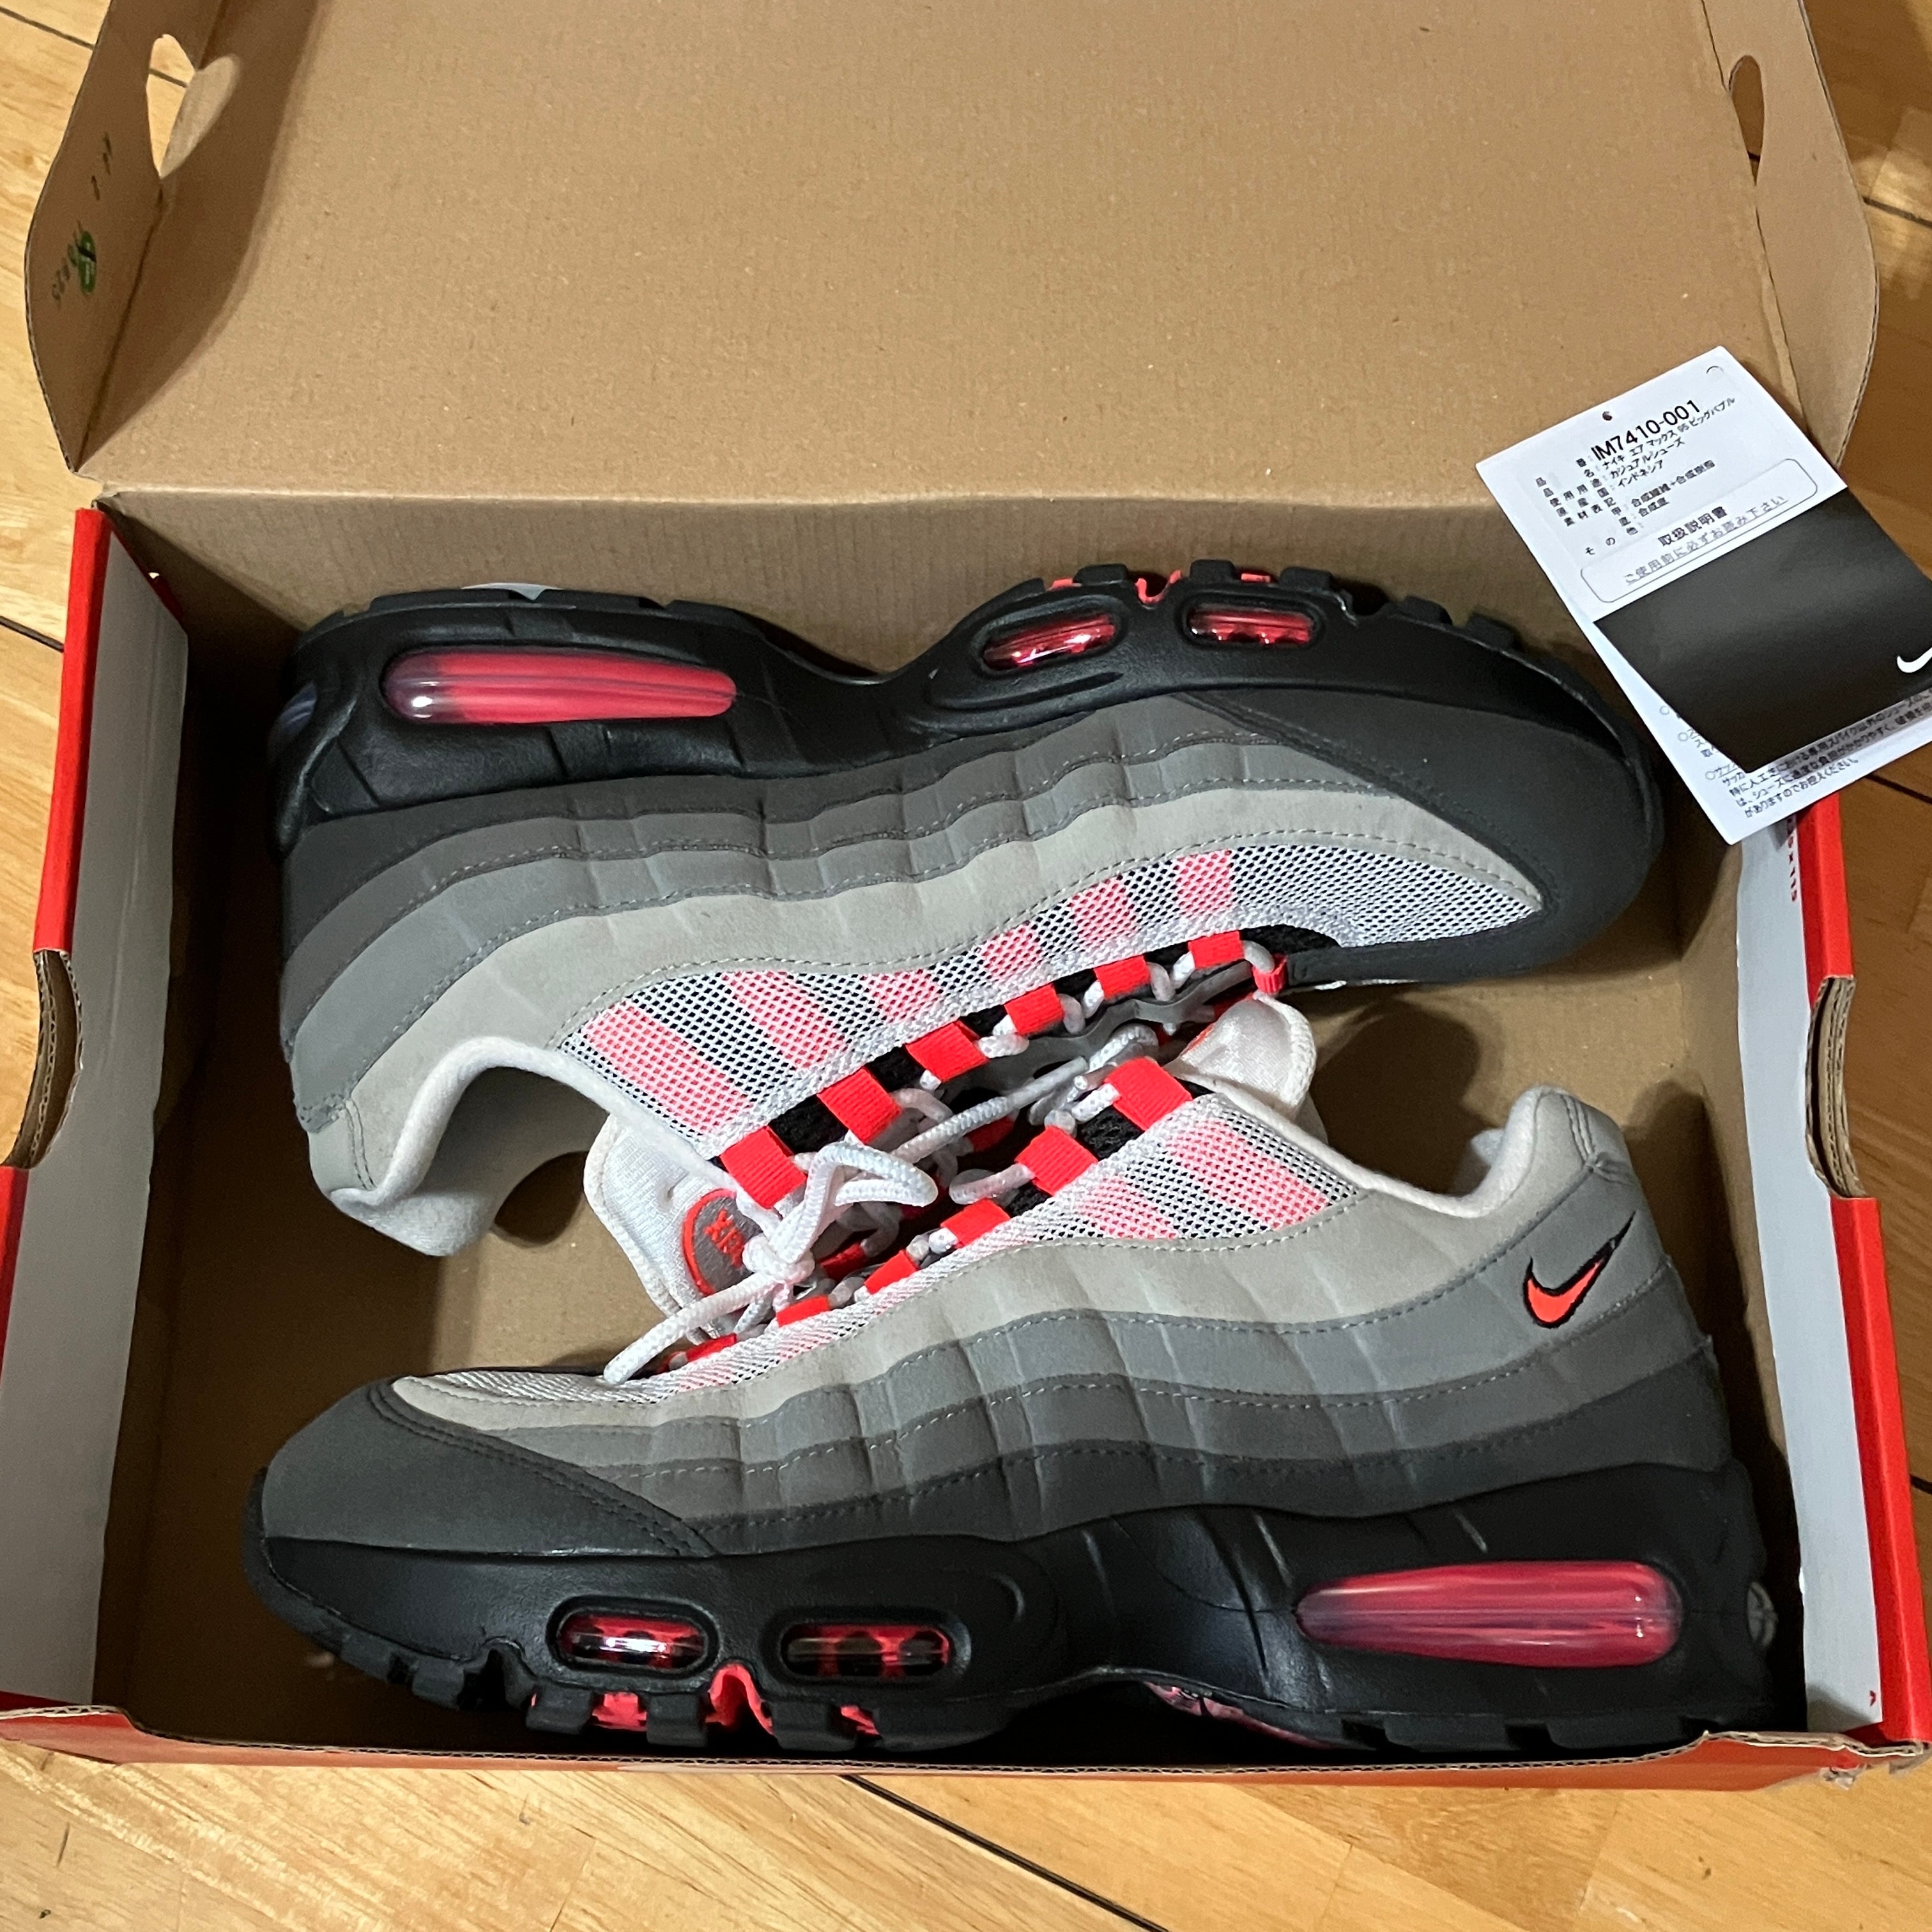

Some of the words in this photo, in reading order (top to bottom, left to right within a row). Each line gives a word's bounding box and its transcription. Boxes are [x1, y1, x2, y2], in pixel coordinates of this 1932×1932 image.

[1591, 400, 1700, 461] IM7410-001
[1602, 455, 1625, 470] ナイキ
[1630, 444, 1644, 457] エア
[1646, 430, 1678, 446] マックス
[1610, 437, 1685, 479] カジュアルシューズ
[1618, 460, 1664, 487] インドネシア
[1658, 506, 1728, 546] 取扱説明書
